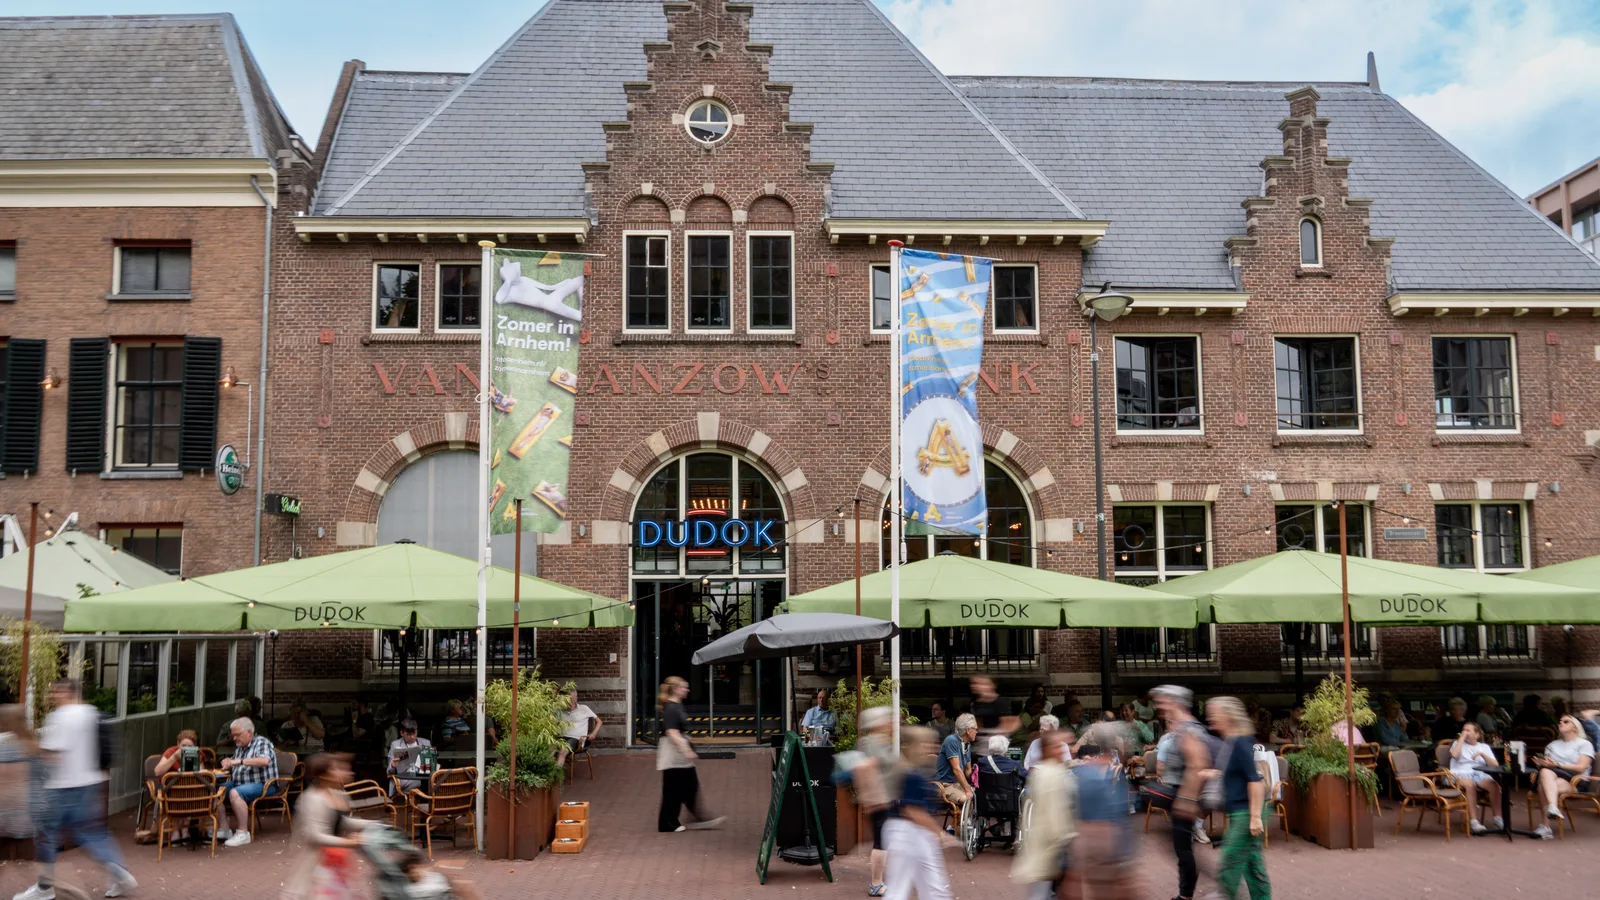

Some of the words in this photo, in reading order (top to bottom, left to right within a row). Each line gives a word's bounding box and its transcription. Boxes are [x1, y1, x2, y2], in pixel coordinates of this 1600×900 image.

[497, 315, 554, 333] Zomer
[558, 320, 575, 335] in
[496, 334, 571, 352] Arnhem!
[639, 519, 776, 548] DUDOK
[294, 605, 366, 622] DUDOK
[960, 603, 1030, 620] DUDOK
[1379, 598, 1448, 615] DUDOK
[792, 779, 820, 787] DUOK
